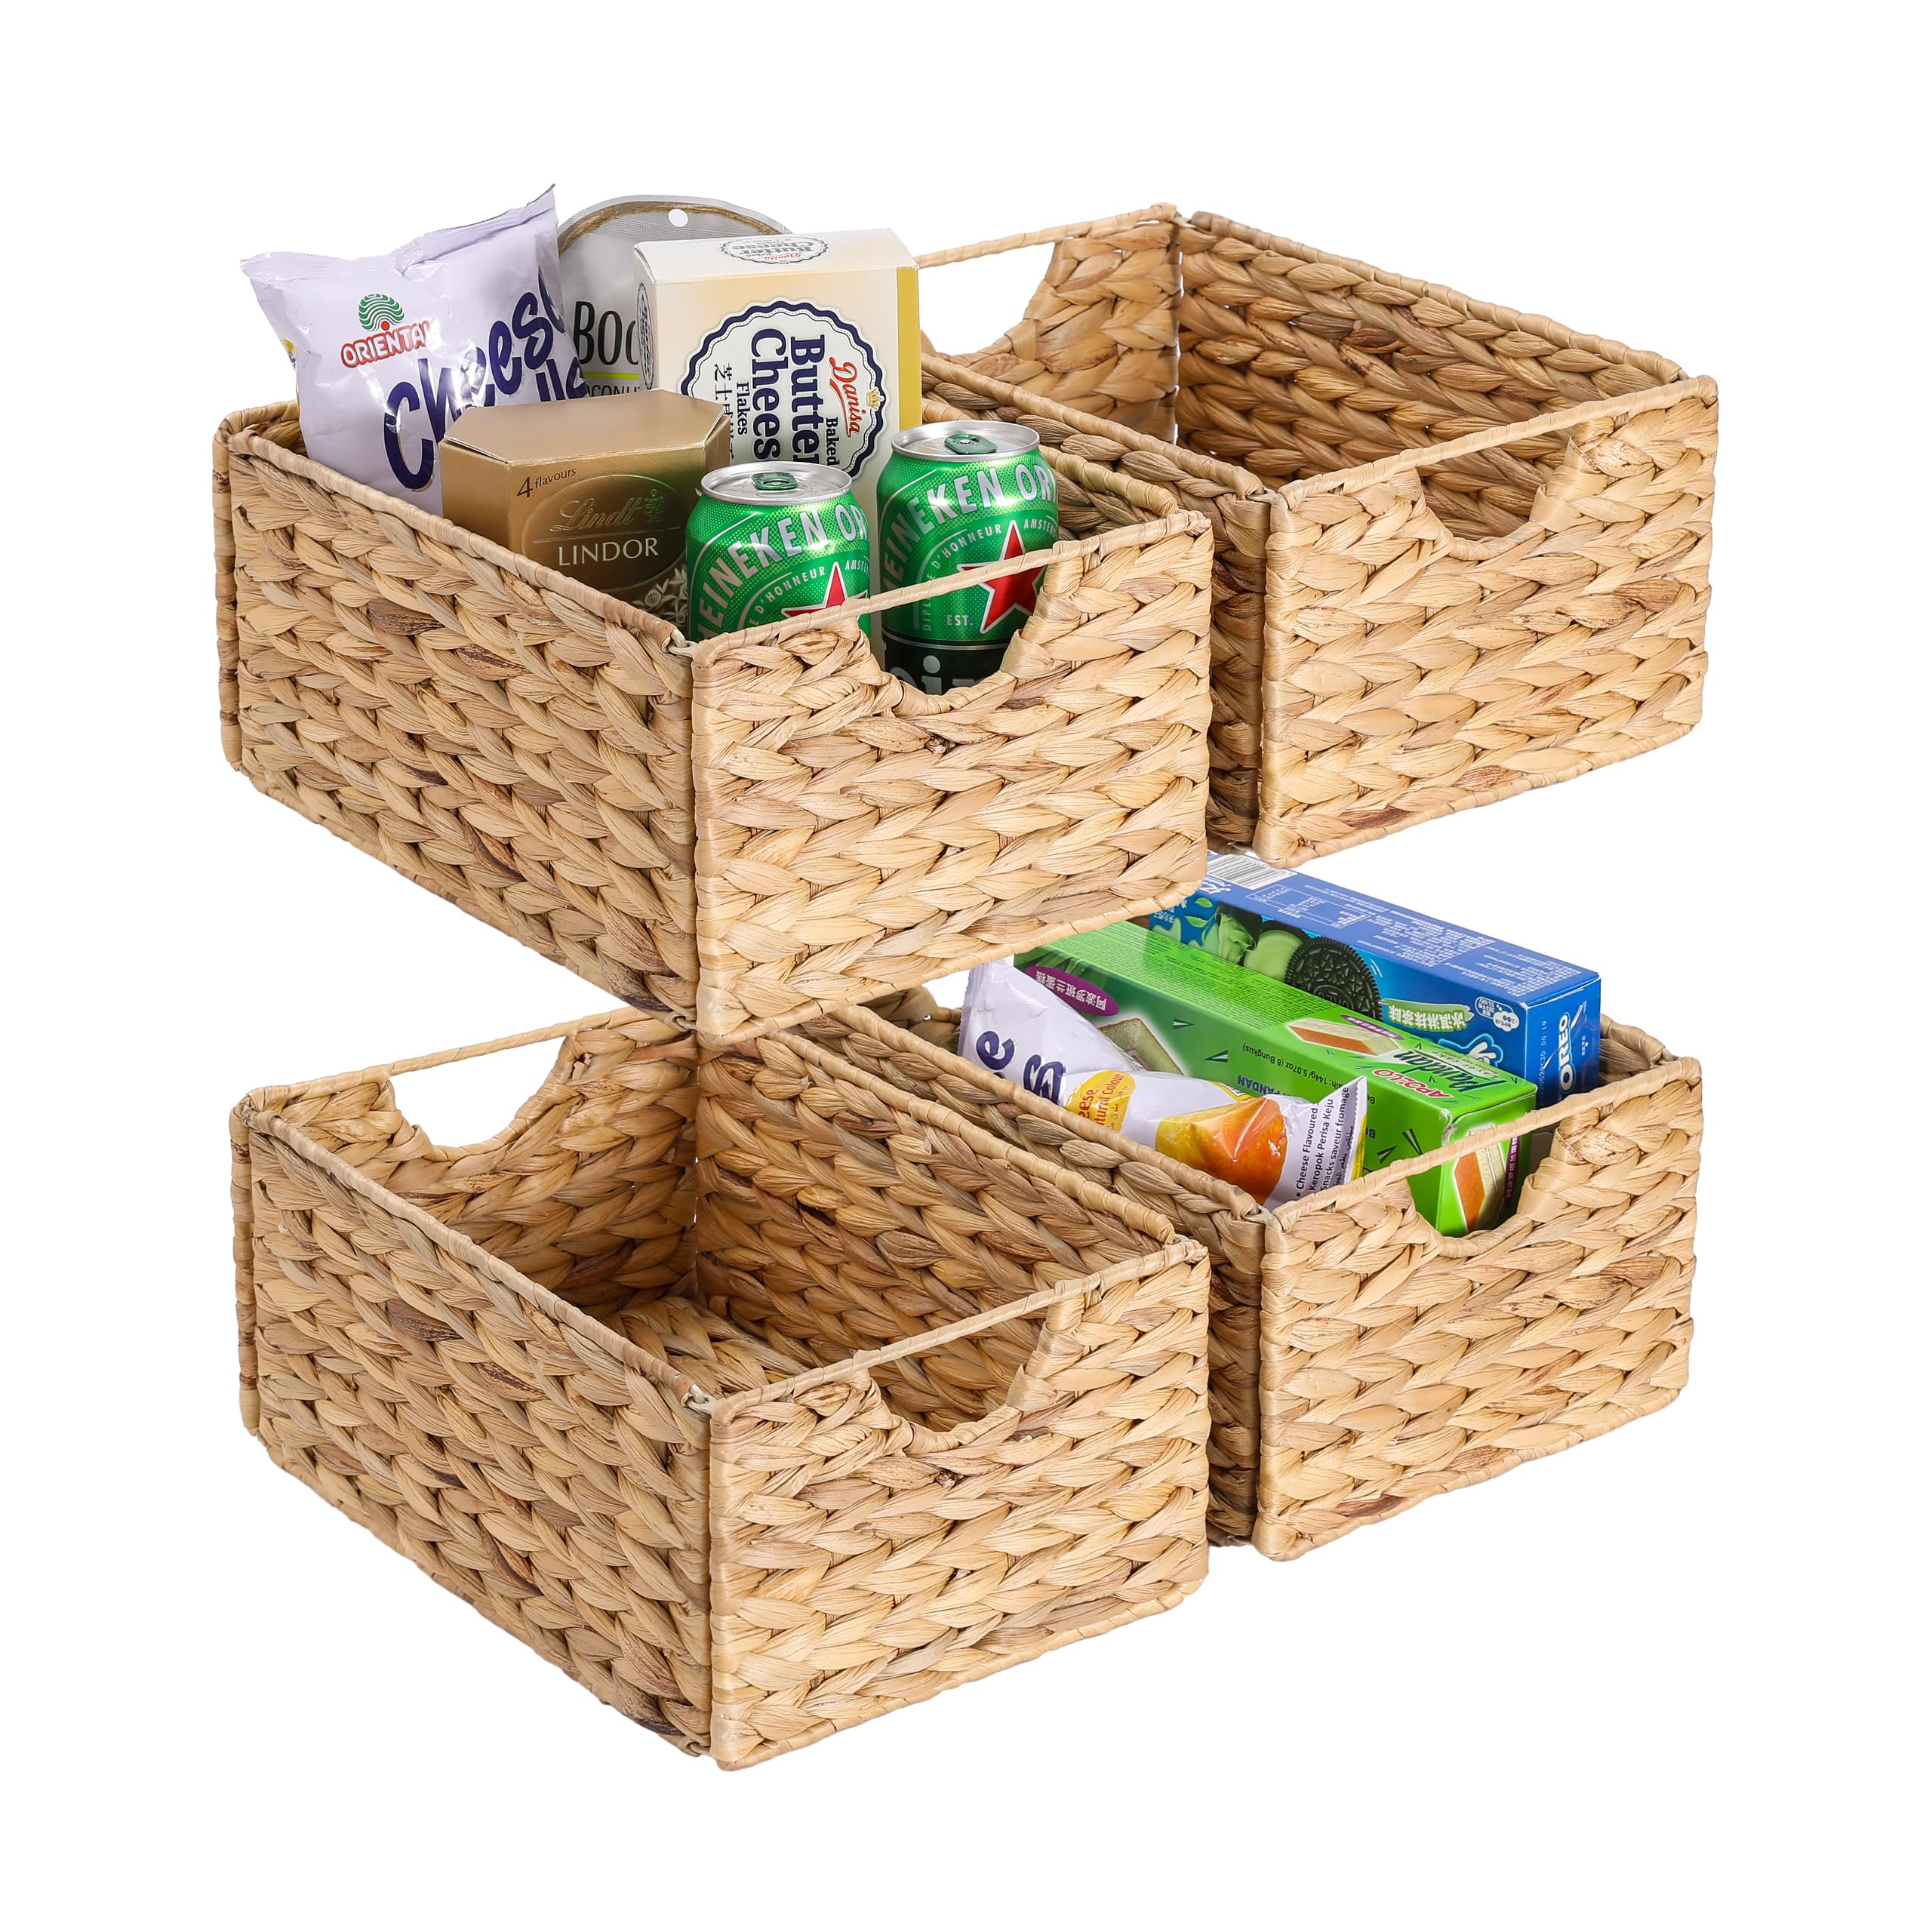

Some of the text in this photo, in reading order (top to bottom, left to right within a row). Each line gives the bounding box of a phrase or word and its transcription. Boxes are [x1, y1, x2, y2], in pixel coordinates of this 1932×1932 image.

[737, 381, 750, 435] Flakes
[752, 328, 789, 460] Chees
[829, 356, 867, 438] Danisa
[826, 417, 840, 466] Baked
[516, 468, 577, 498] 4 flavours
[550, 497, 643, 532] Lindt
[558, 537, 659, 567] LINDOR
[931, 524, 1002, 570] D'HONNEUR
[755, 565, 826, 614] D'HONNEUR
[946, 614, 974, 627] EST.
[1389, 1004, 1466, 1029] 冰淇淋抹茶味
[1242, 1043, 1275, 1064] Bungkus)
[1277, 1057, 1284, 1068] (8
[1285, 1061, 1307, 1077] 5.07oz
[1393, 1050, 1508, 1093] Pandan
[1558, 1014, 1574, 1091] OREO
[1308, 1070, 1327, 1085] 144g/
[1372, 1069, 1454, 1098] APOLLO
[1296, 1107, 1318, 1190] Cheese Flavoured
[1309, 1099, 1335, 1190] Keropok Perisa Keju
[1321, 1087, 1349, 1191] Snacks saveur fromage
